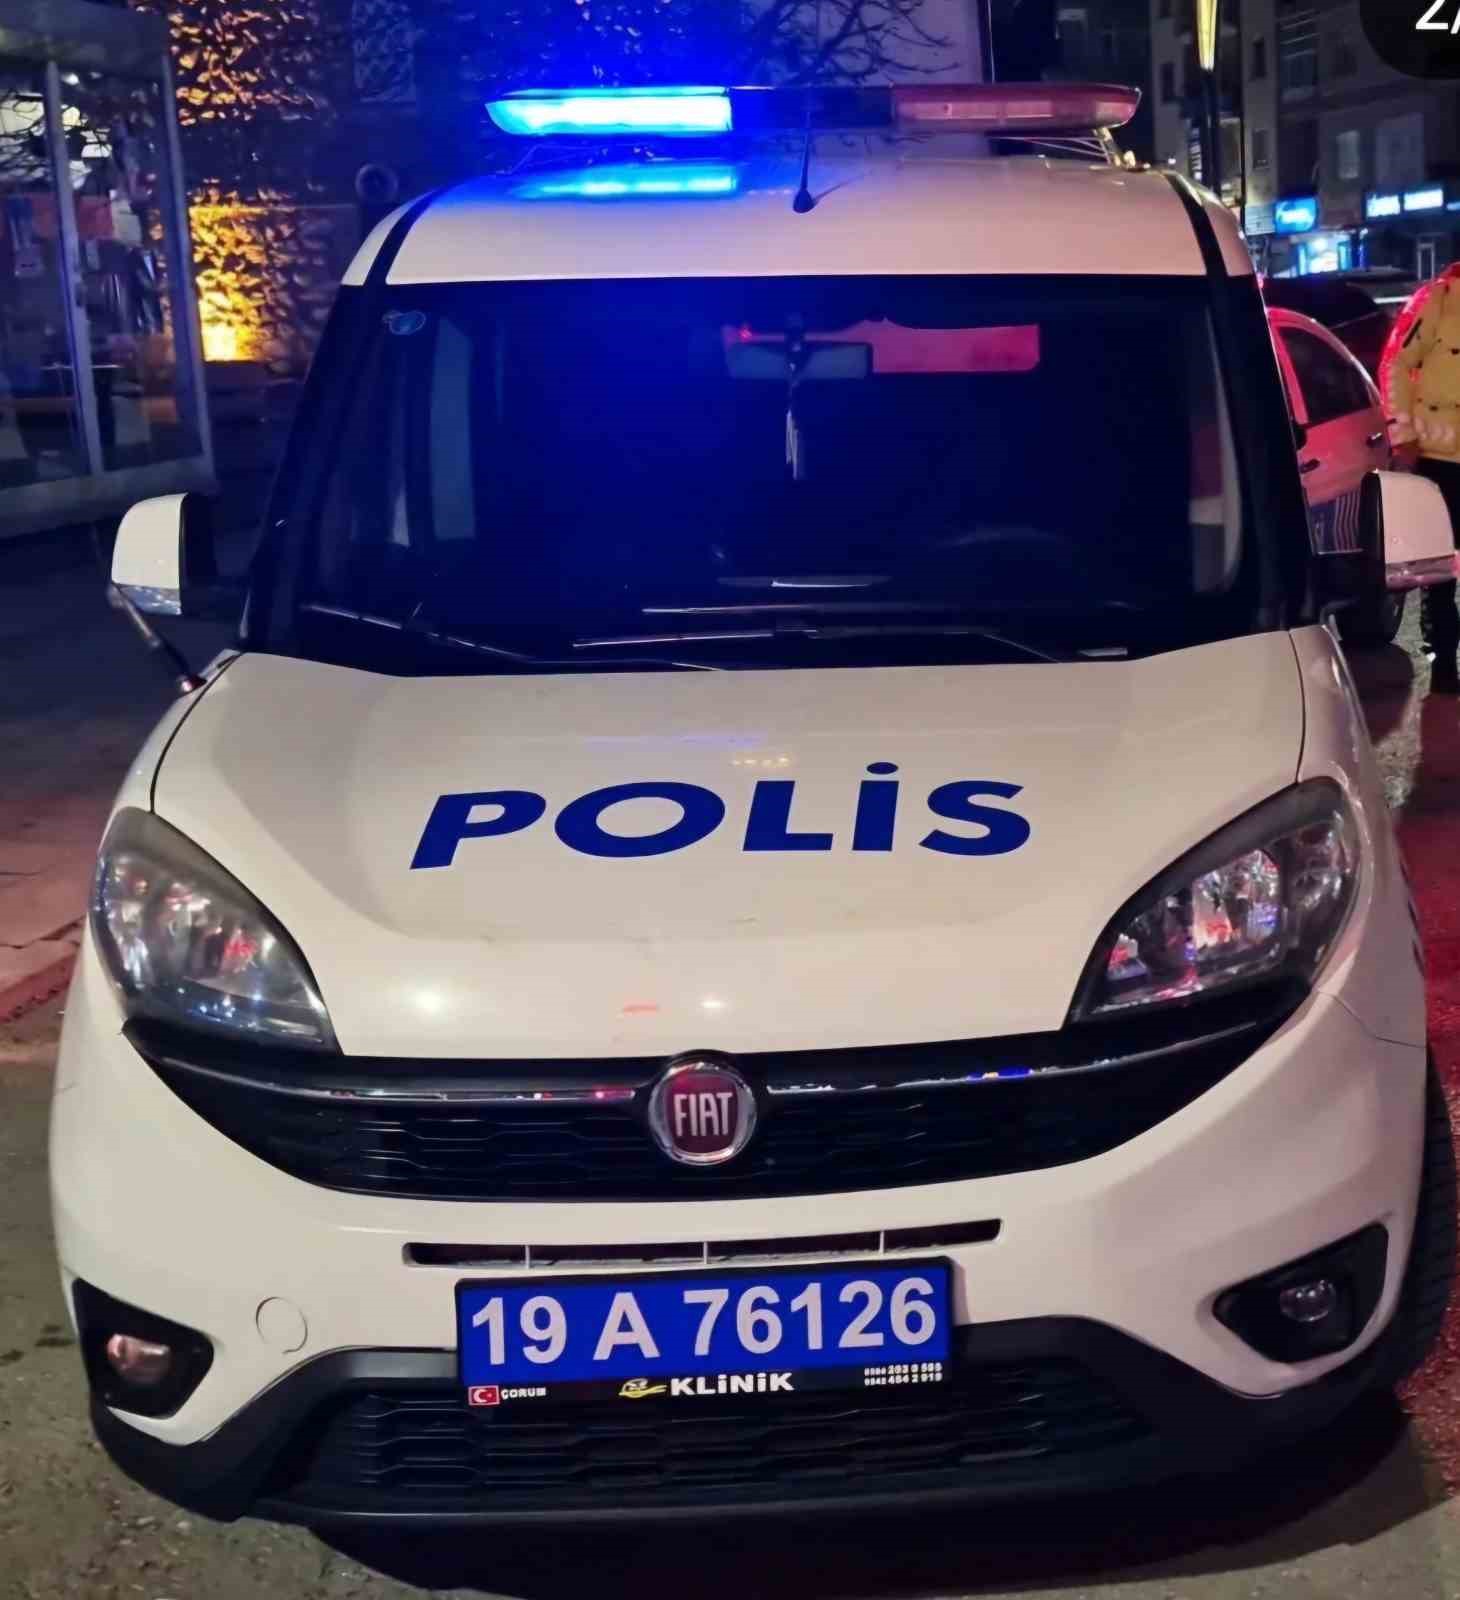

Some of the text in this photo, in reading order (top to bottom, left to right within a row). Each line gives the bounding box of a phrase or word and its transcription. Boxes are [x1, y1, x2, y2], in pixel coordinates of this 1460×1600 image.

[410, 762, 1031, 869] POLİS
[673, 1092, 733, 1137] FIAT
[472, 1277, 936, 1366] 19 A 76126
